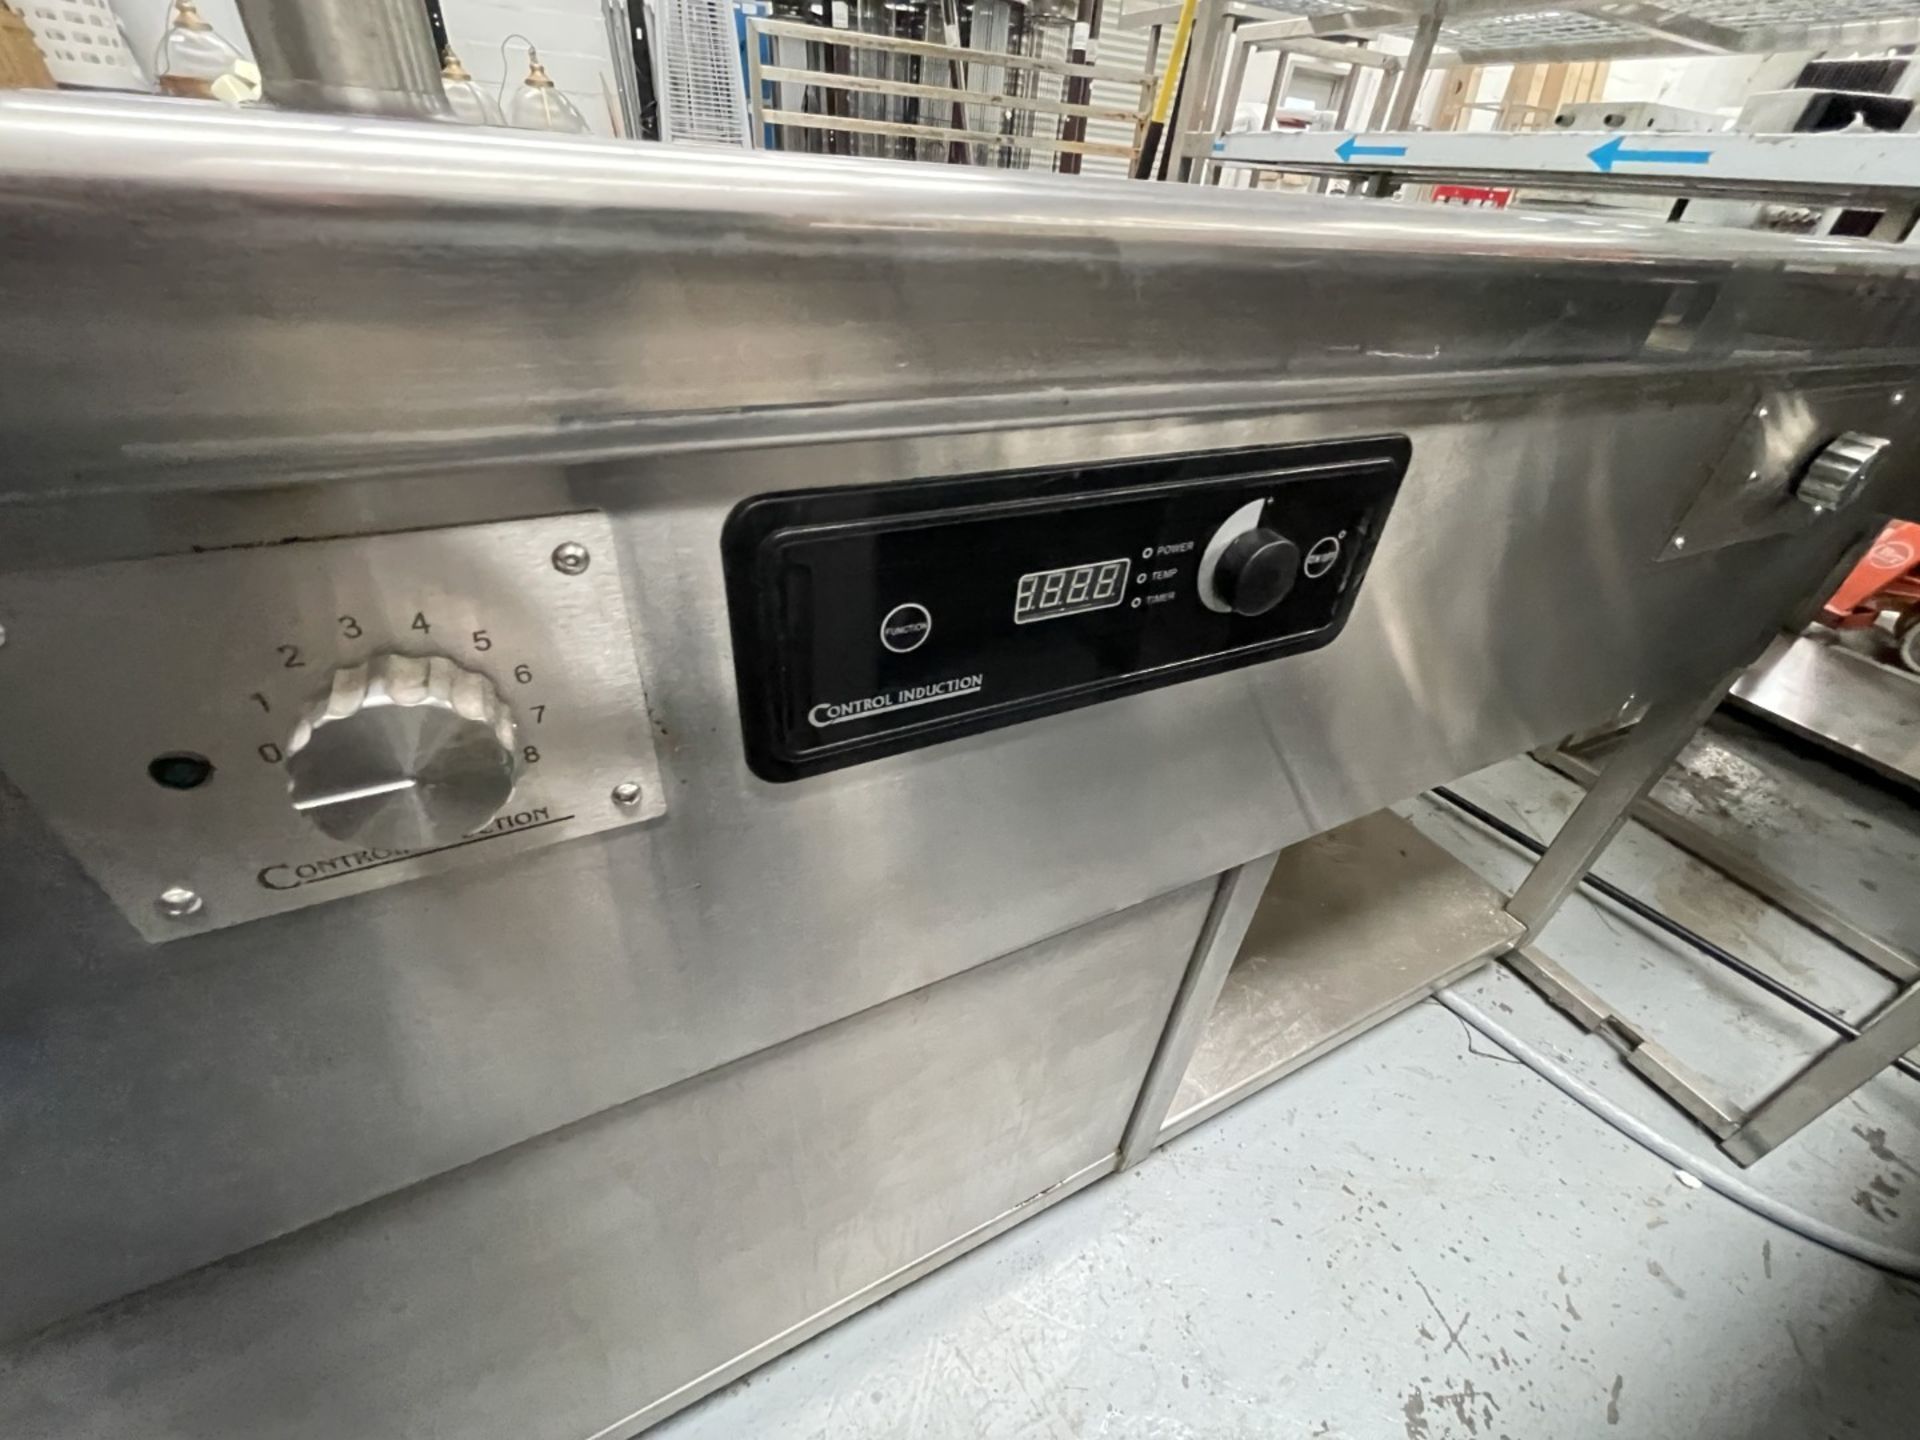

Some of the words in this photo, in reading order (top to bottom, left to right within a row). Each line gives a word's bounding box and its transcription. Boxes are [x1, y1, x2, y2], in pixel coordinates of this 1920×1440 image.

[1157, 541, 1194, 555] POWER
[1152, 567, 1178, 581] TEMP
[338, 615, 363, 639] 3
[411, 612, 431, 634] 4
[885, 622, 929, 636] FUNCTION
[472, 630, 492, 651] 5
[277, 644, 305, 669] 2
[514, 664, 533, 684] 6
[252, 692, 270, 714] 1
[808, 693, 893, 728] CONTROL
[898, 673, 983, 703] INDUCTION
[529, 705, 546, 724] 7
[258, 743, 283, 764] 0
[523, 746, 541, 763] 8
